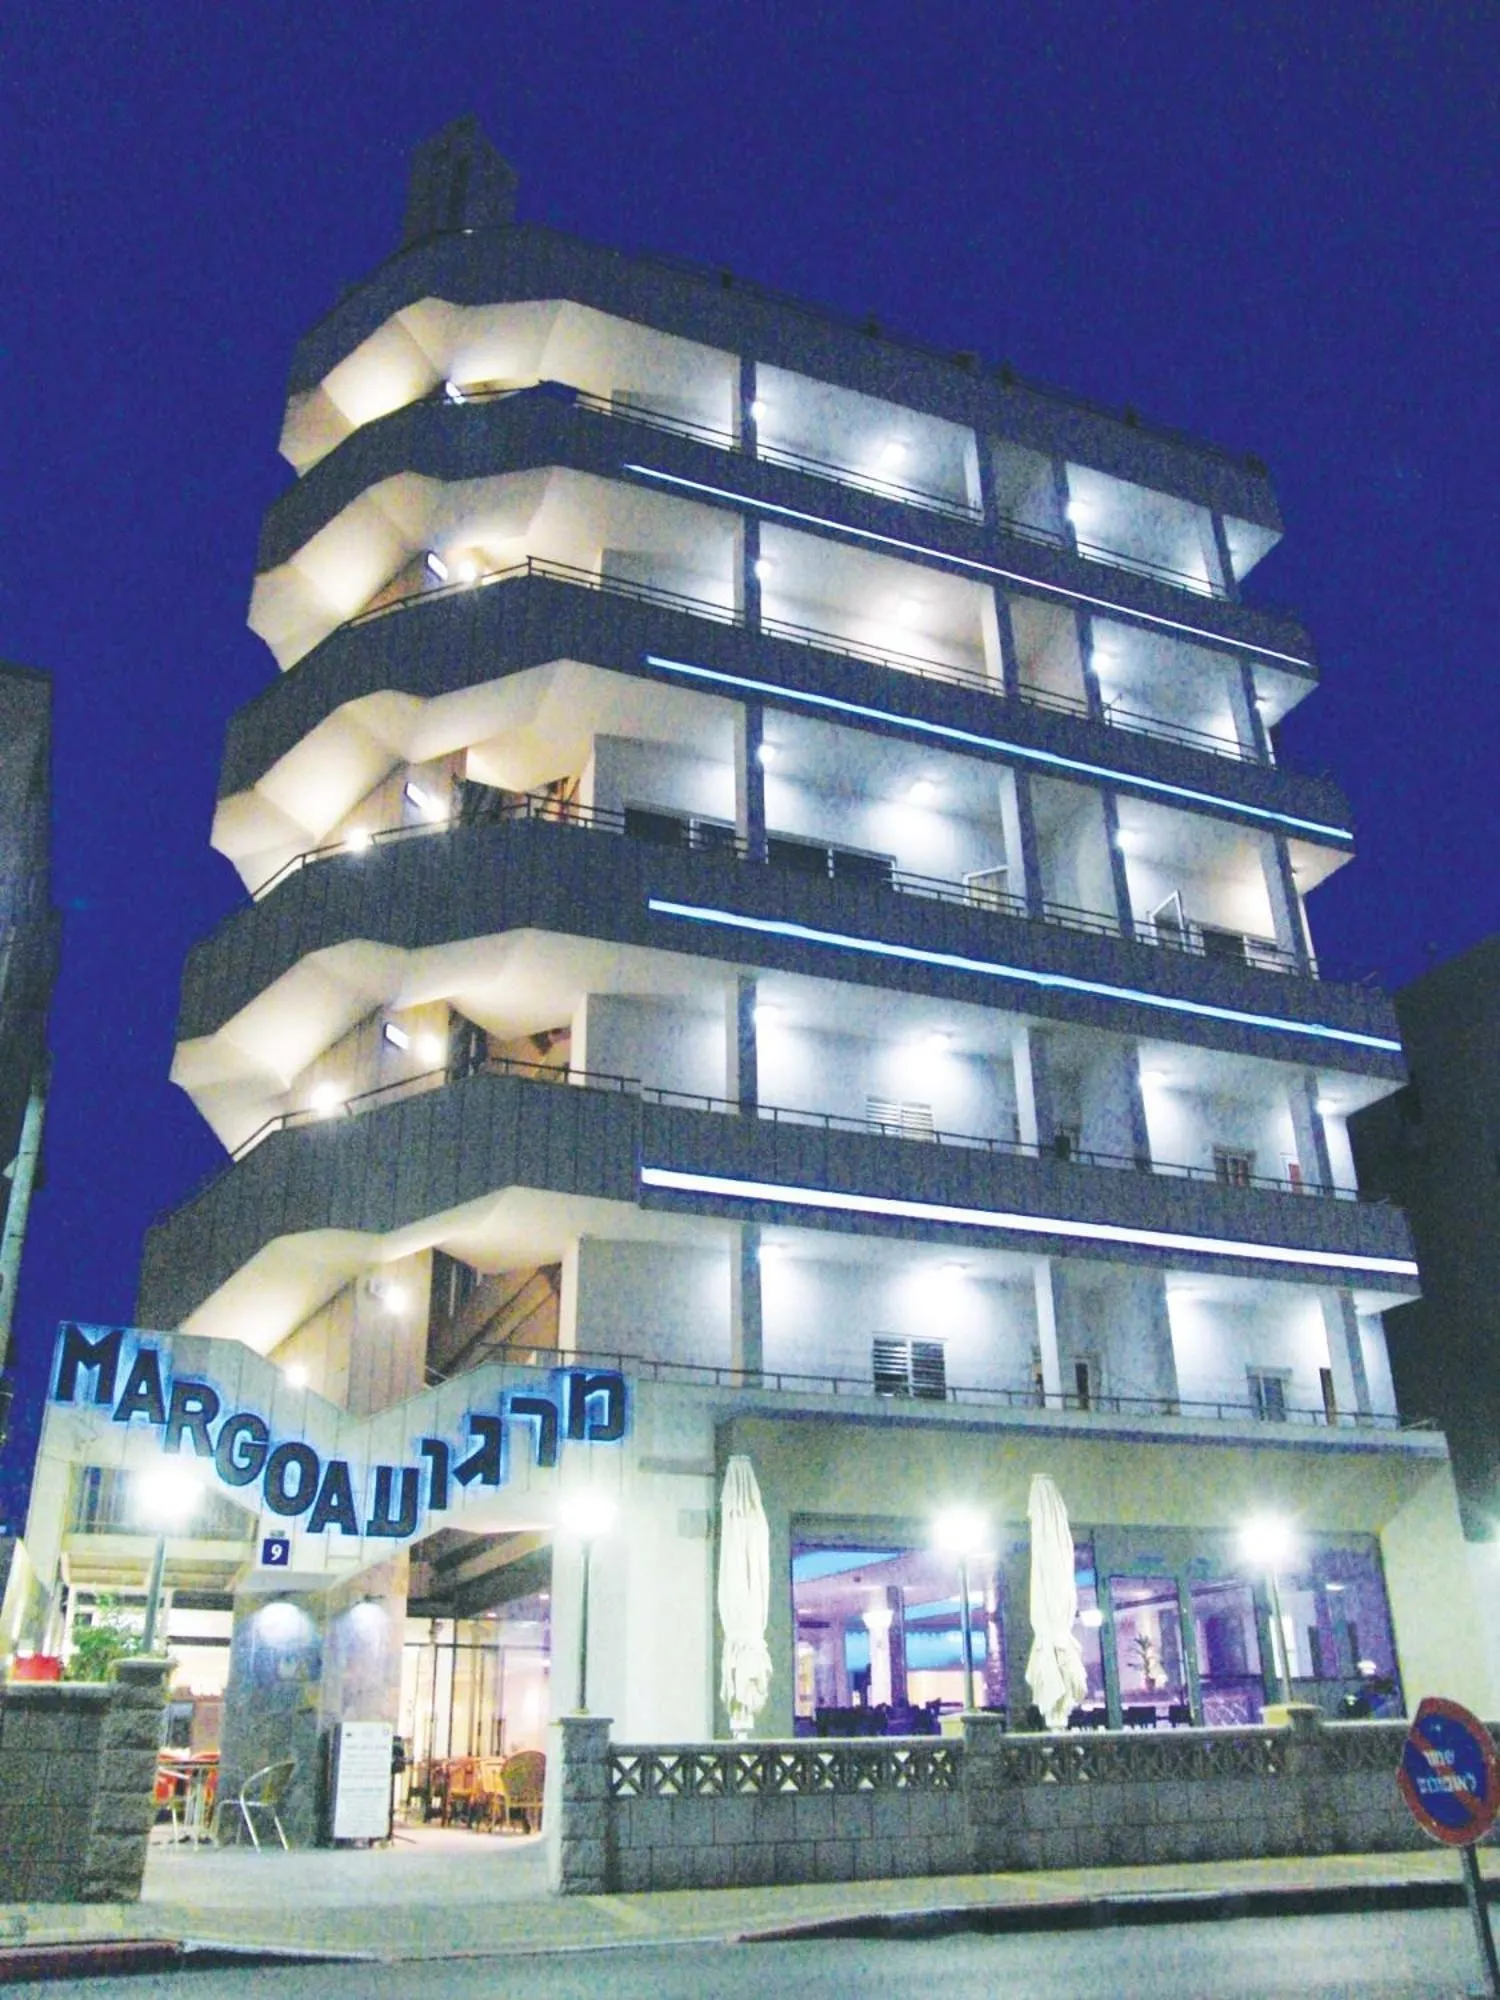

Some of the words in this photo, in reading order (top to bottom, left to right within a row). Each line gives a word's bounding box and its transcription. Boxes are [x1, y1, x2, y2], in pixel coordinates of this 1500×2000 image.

[55, 1325, 358, 1535] MARGOA
[366, 1373, 625, 1537] מרגוע
[271, 1543, 282, 1561] 9
